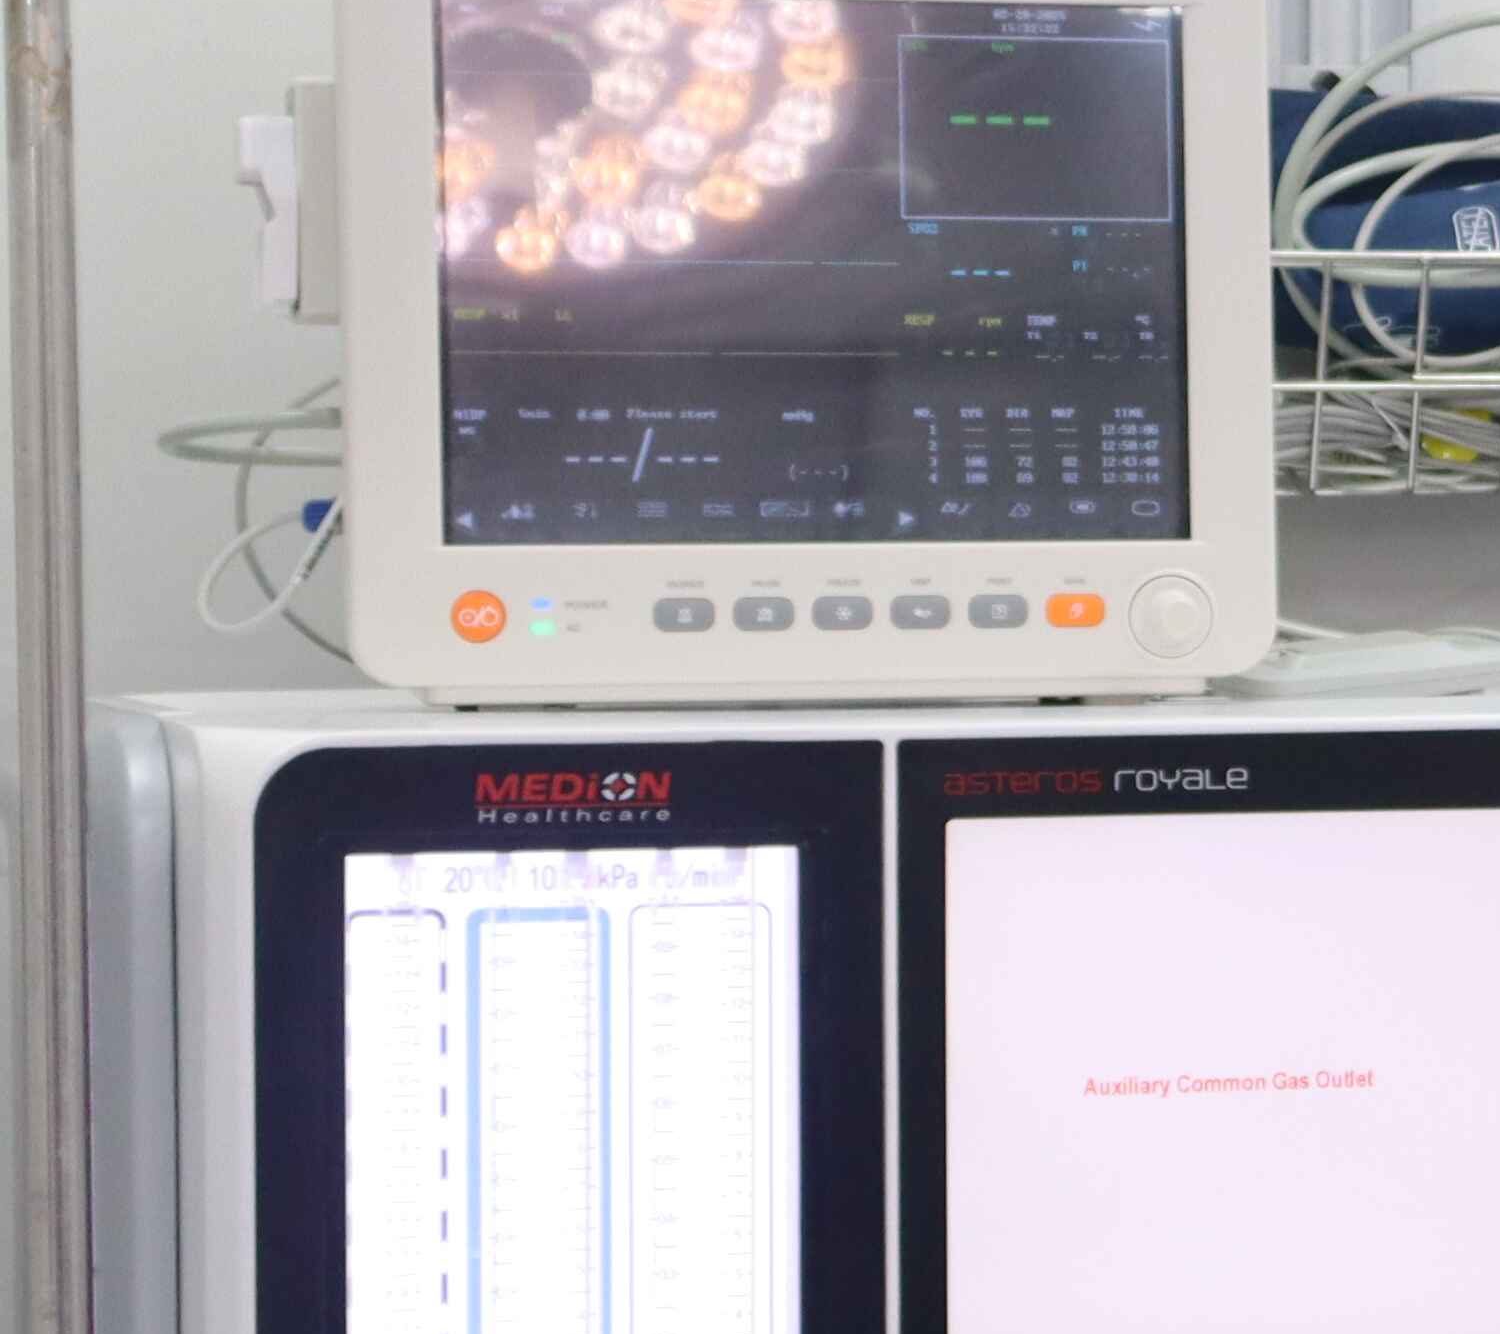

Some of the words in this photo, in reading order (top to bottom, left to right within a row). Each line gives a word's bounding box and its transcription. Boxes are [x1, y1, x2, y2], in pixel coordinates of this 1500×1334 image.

[477, 808, 671, 824] Healthcare
[1084, 1076, 1171, 1098] Auxiliary
[1176, 1074, 1267, 1094] Common
[1272, 1071, 1309, 1091] Gas
[1315, 1069, 1377, 1088] Outlet
